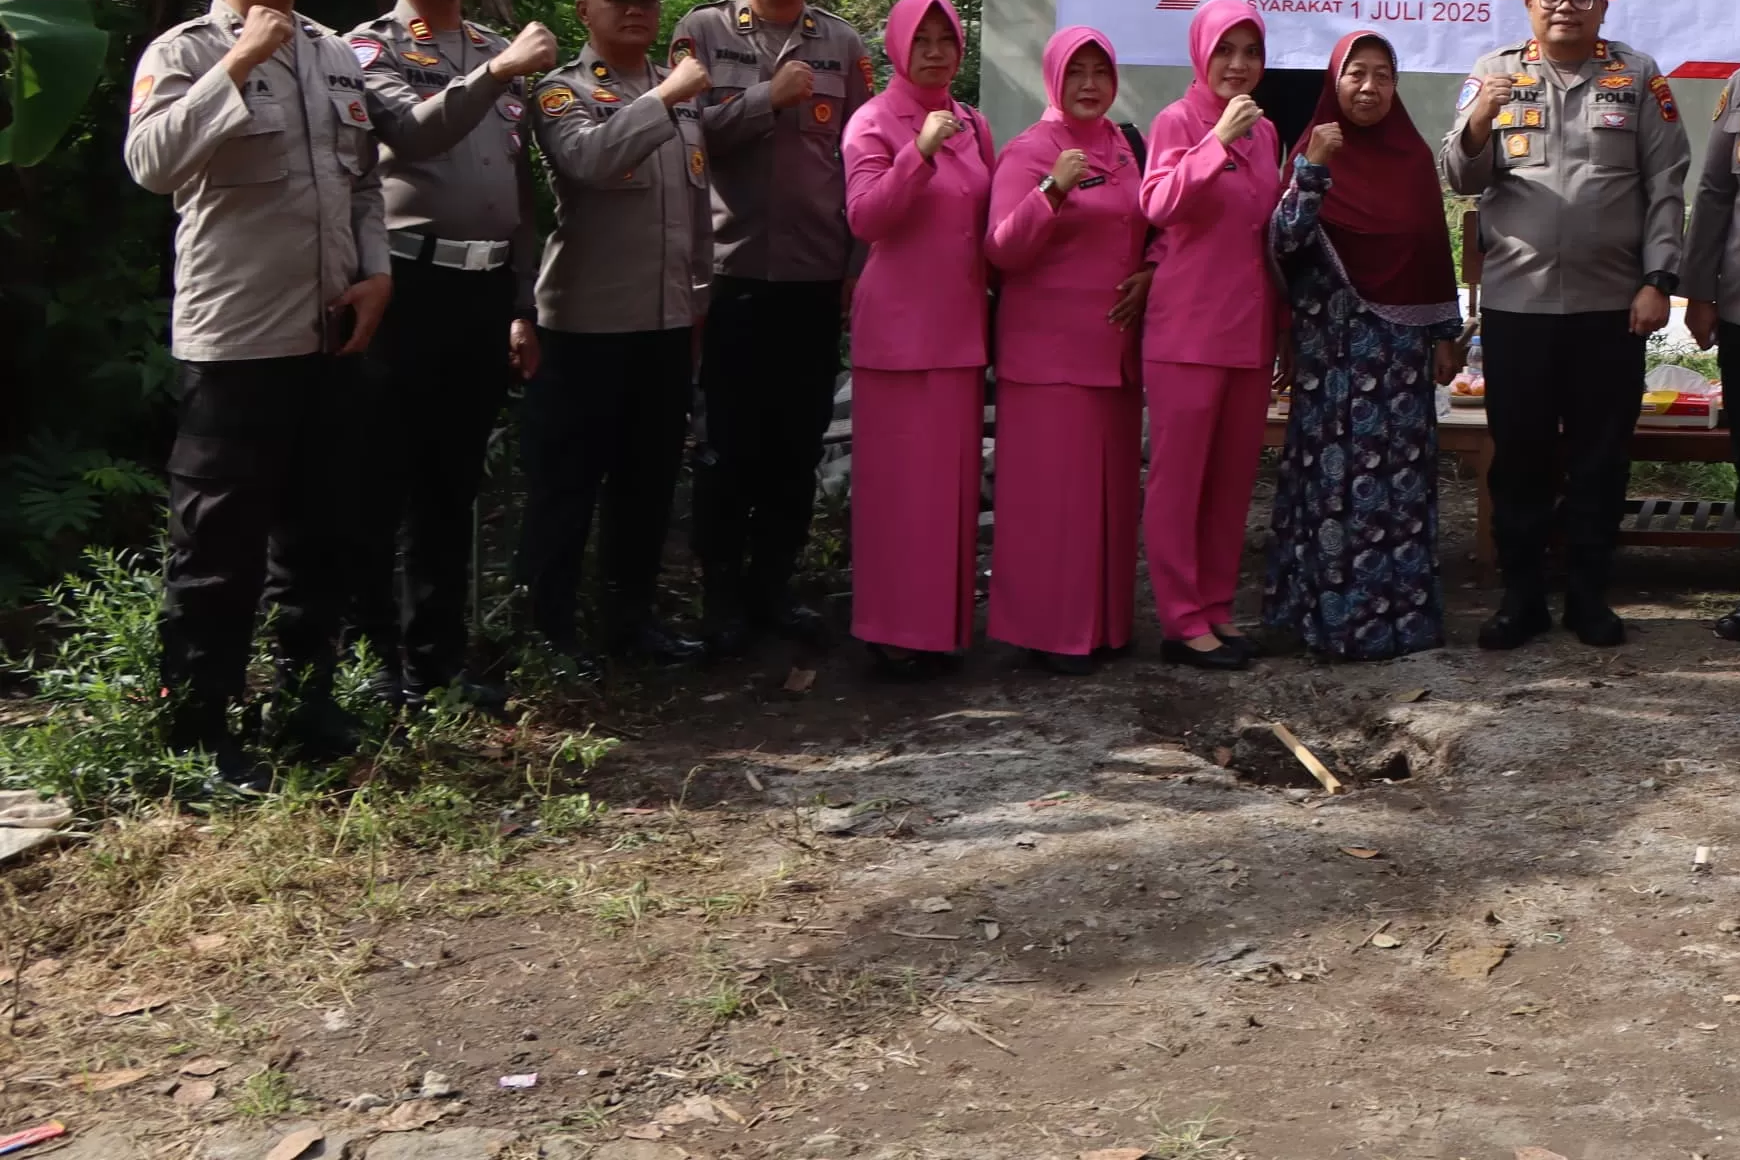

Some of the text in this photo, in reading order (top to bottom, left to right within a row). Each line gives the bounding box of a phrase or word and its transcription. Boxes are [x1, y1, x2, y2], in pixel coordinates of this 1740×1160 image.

[1246, 0, 1343, 13] SYARAKAT
[1350, 1, 1491, 22] 1 JULI 2025
[1595, 92, 1636, 104] POLRI
